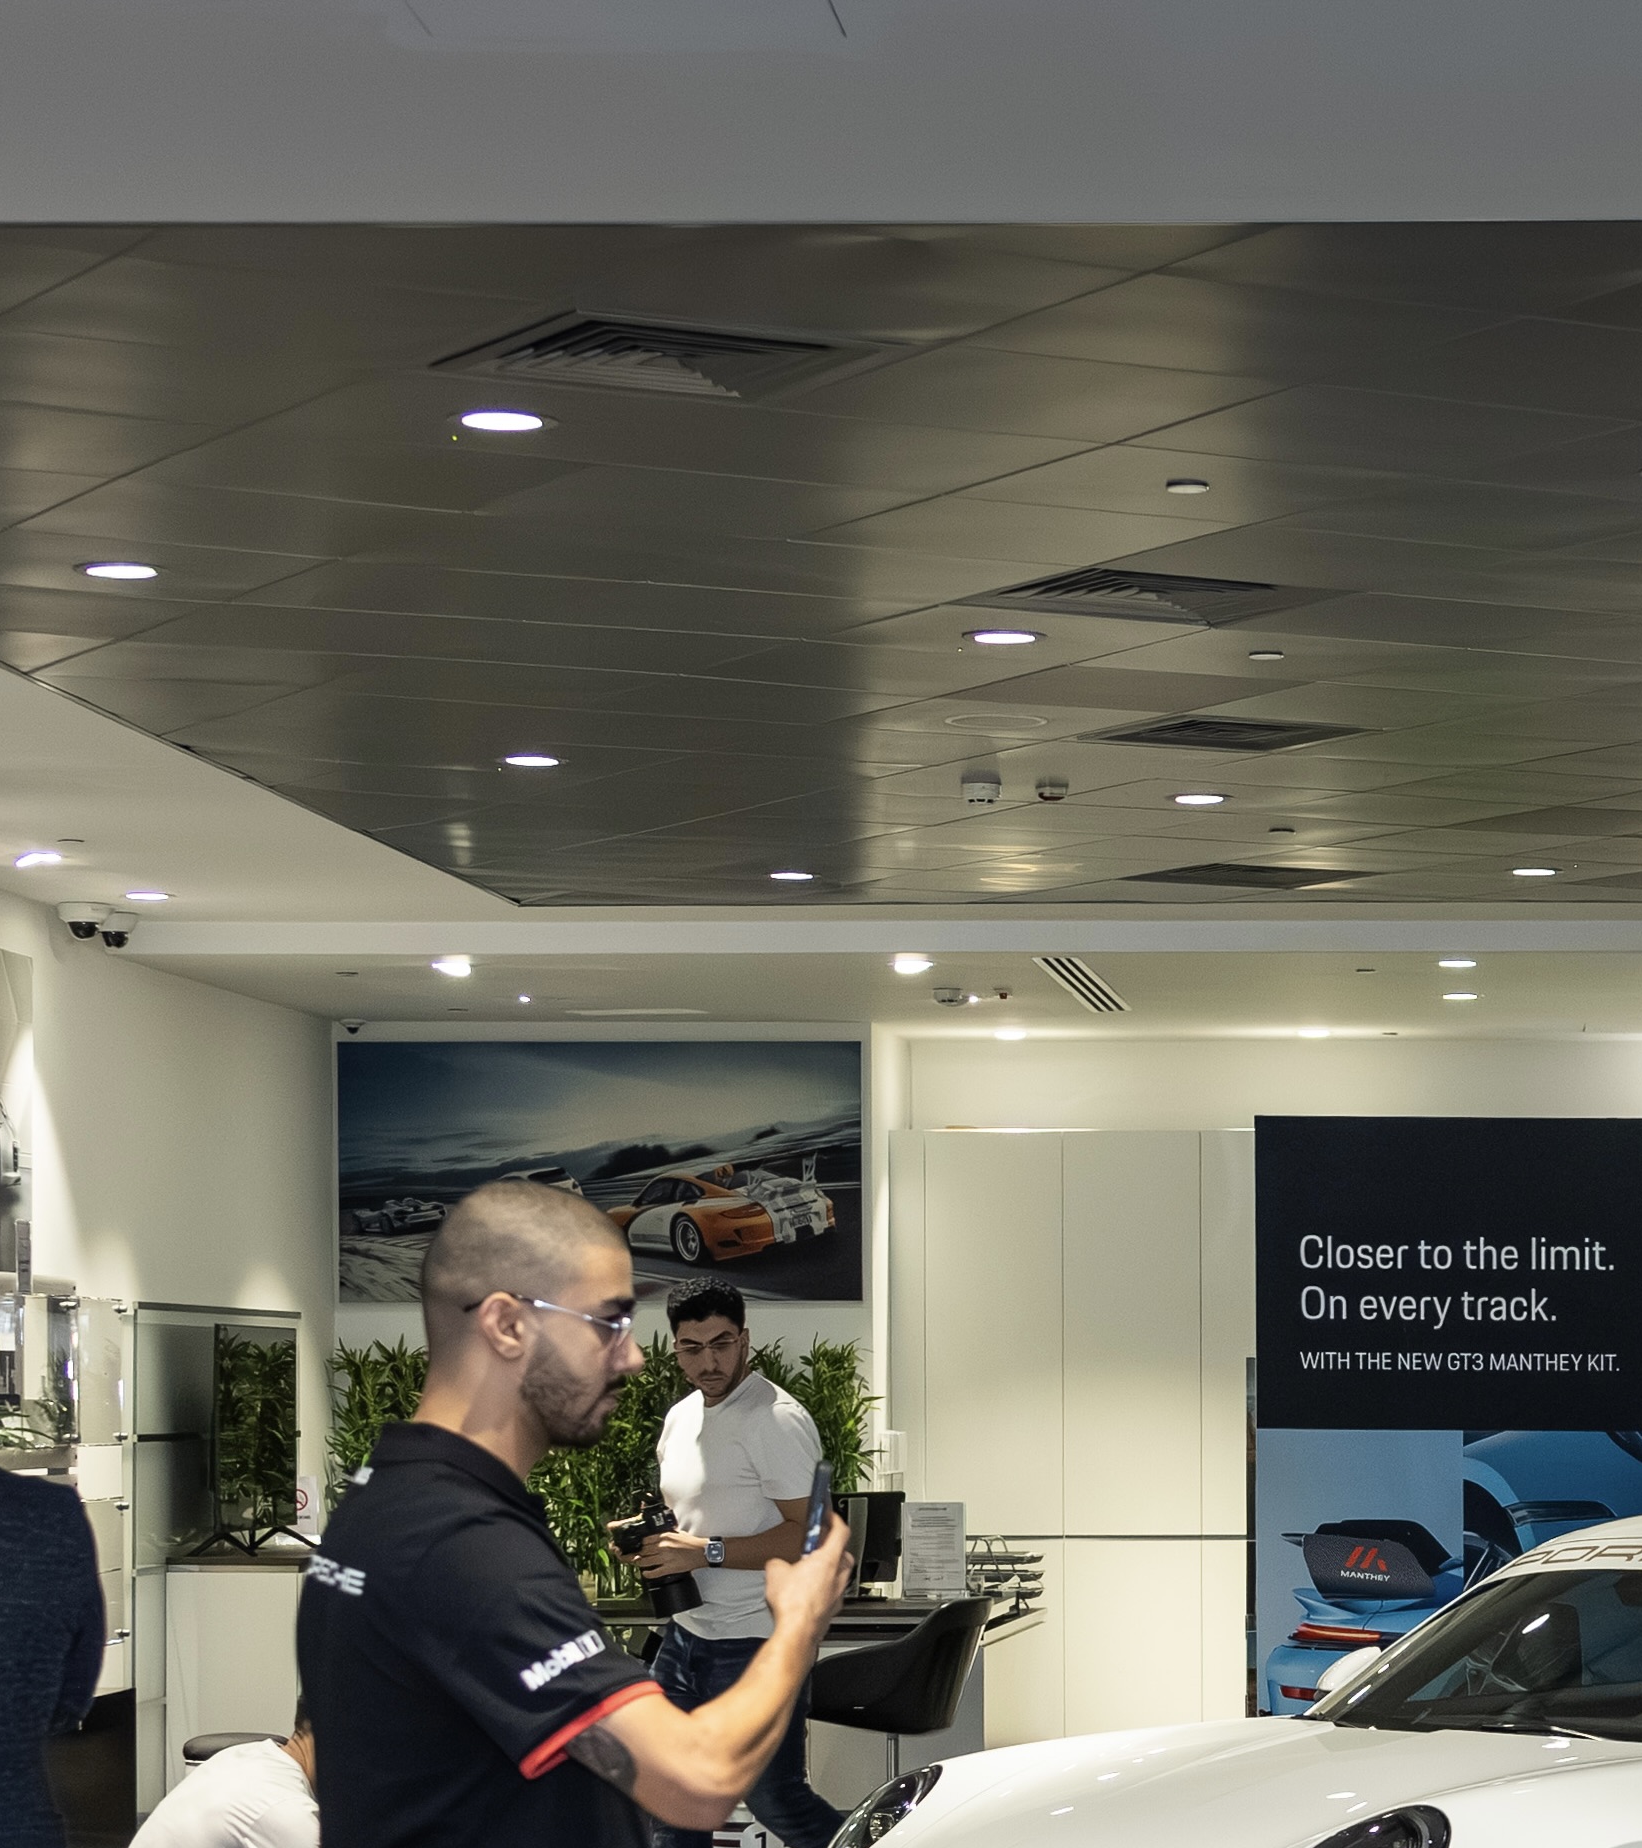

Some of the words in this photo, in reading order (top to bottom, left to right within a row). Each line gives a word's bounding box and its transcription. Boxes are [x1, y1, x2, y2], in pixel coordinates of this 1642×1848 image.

[1299, 1234, 1409, 1269] Closer
[1418, 1240, 1452, 1270] to
[1463, 1237, 1519, 1270] the
[1531, 1237, 1615, 1271] limit.
[1301, 1286, 1348, 1320] On
[1359, 1294, 1452, 1330] every
[1461, 1288, 1557, 1321] track.
[1300, 1351, 1350, 1370] WITH
[1355, 1352, 1392, 1370] THE
[1397, 1352, 1443, 1371] NEW
[1447, 1352, 1484, 1371] GT3
[1489, 1353, 1583, 1372] MANTHEY
[1587, 1354, 1620, 1372] KIT.
[1340, 1570, 1391, 1582] MANTHEY
[519, 1641, 587, 1691] Mobil
